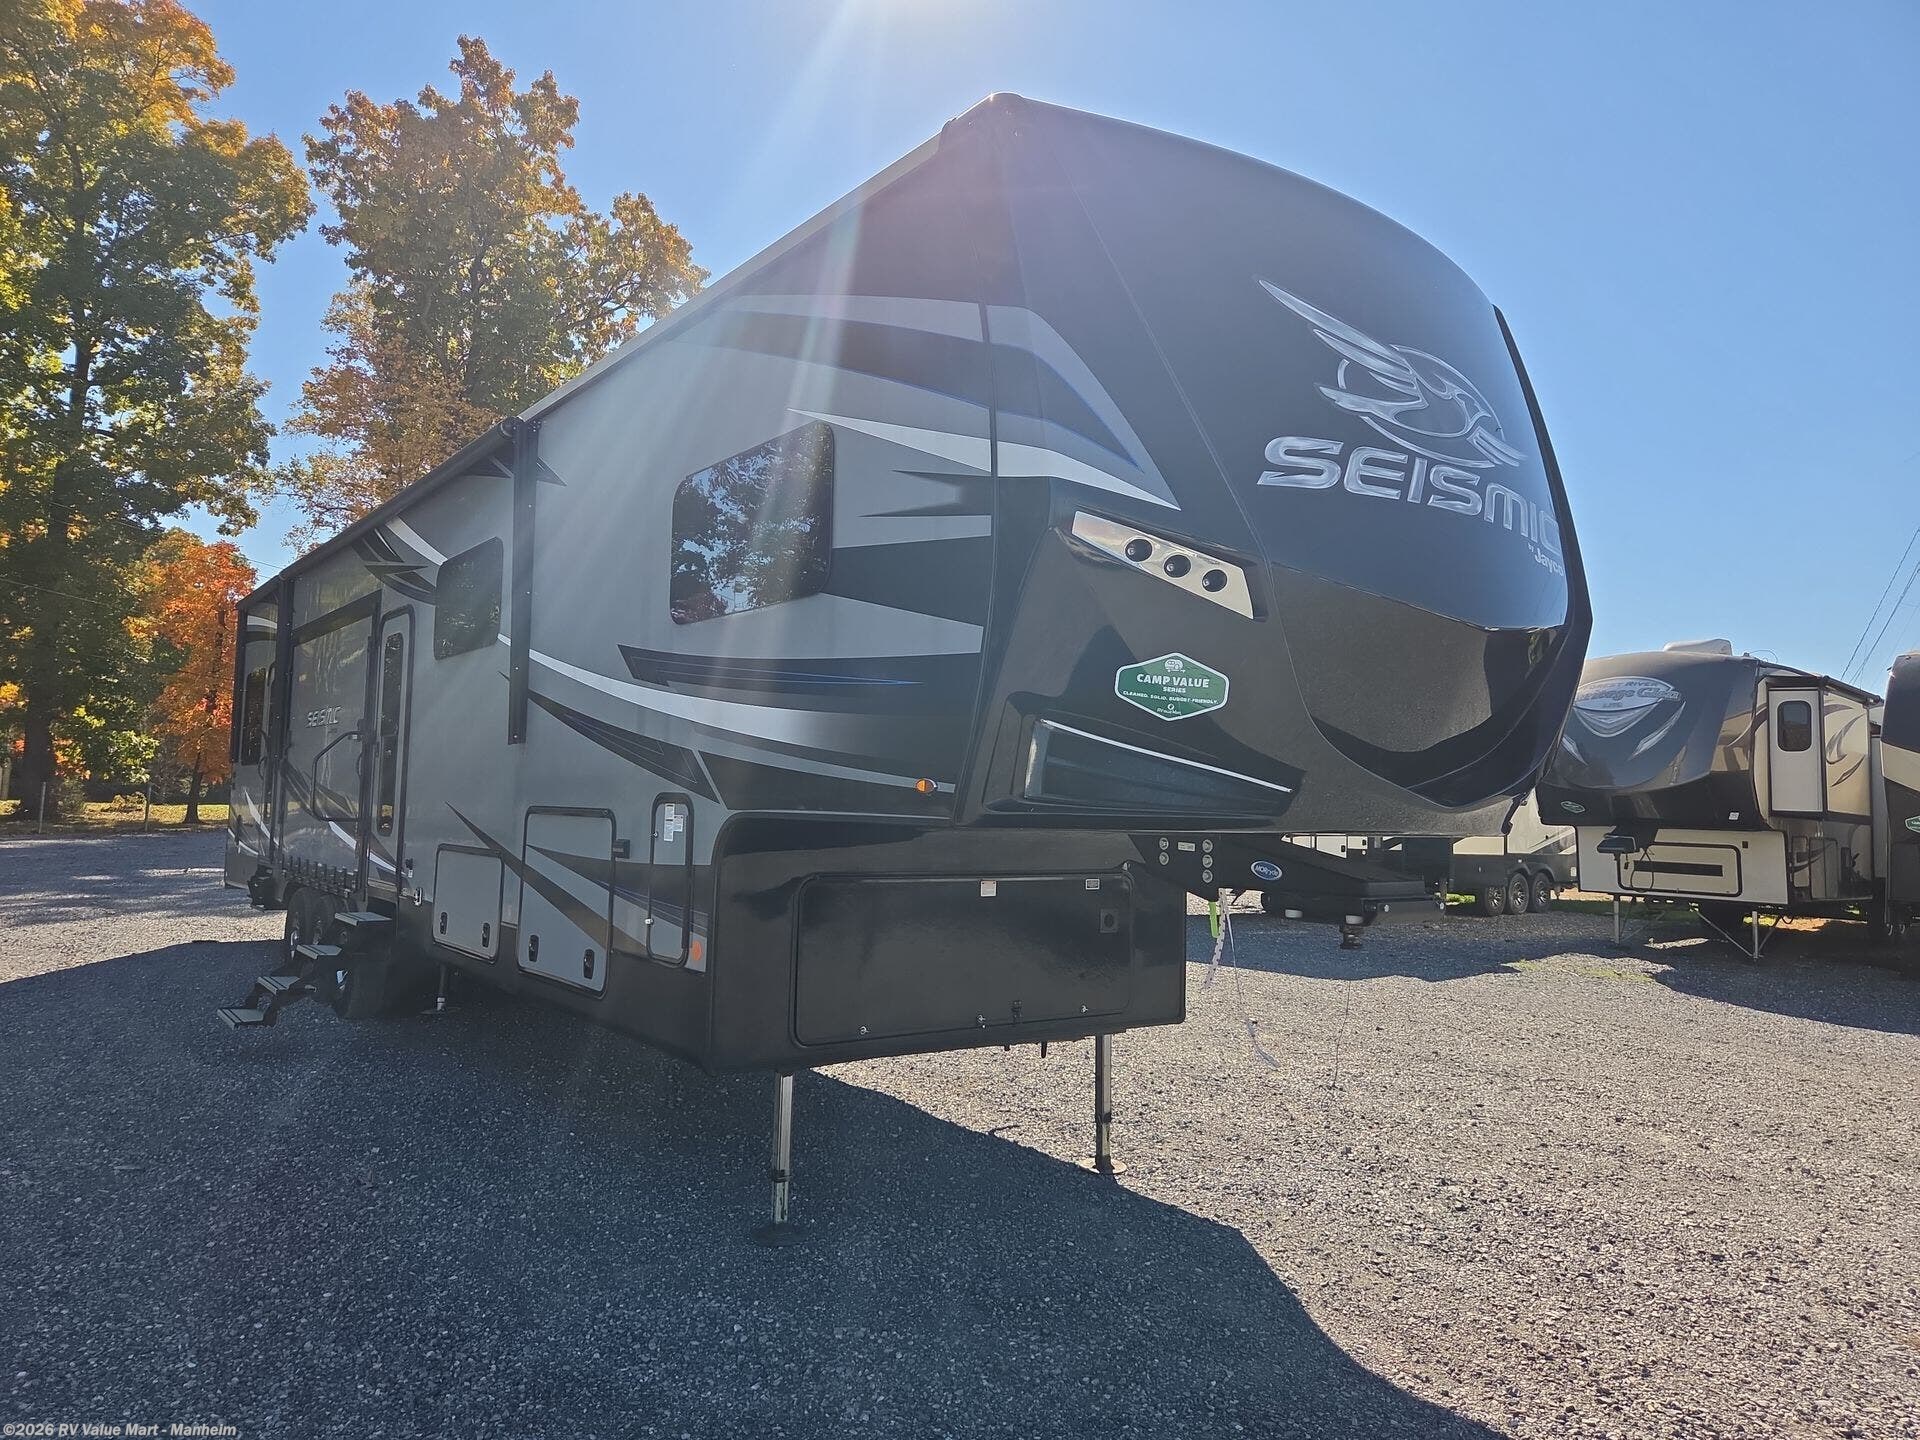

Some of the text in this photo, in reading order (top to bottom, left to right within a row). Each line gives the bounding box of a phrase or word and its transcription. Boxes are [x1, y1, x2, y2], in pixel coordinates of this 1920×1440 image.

[1256, 436, 1561, 557] SEISMIC
[1534, 547, 1565, 577] Jayco
[1136, 673, 1210, 688] CAMP VALUE
[1162, 686, 1187, 694] SERIES
